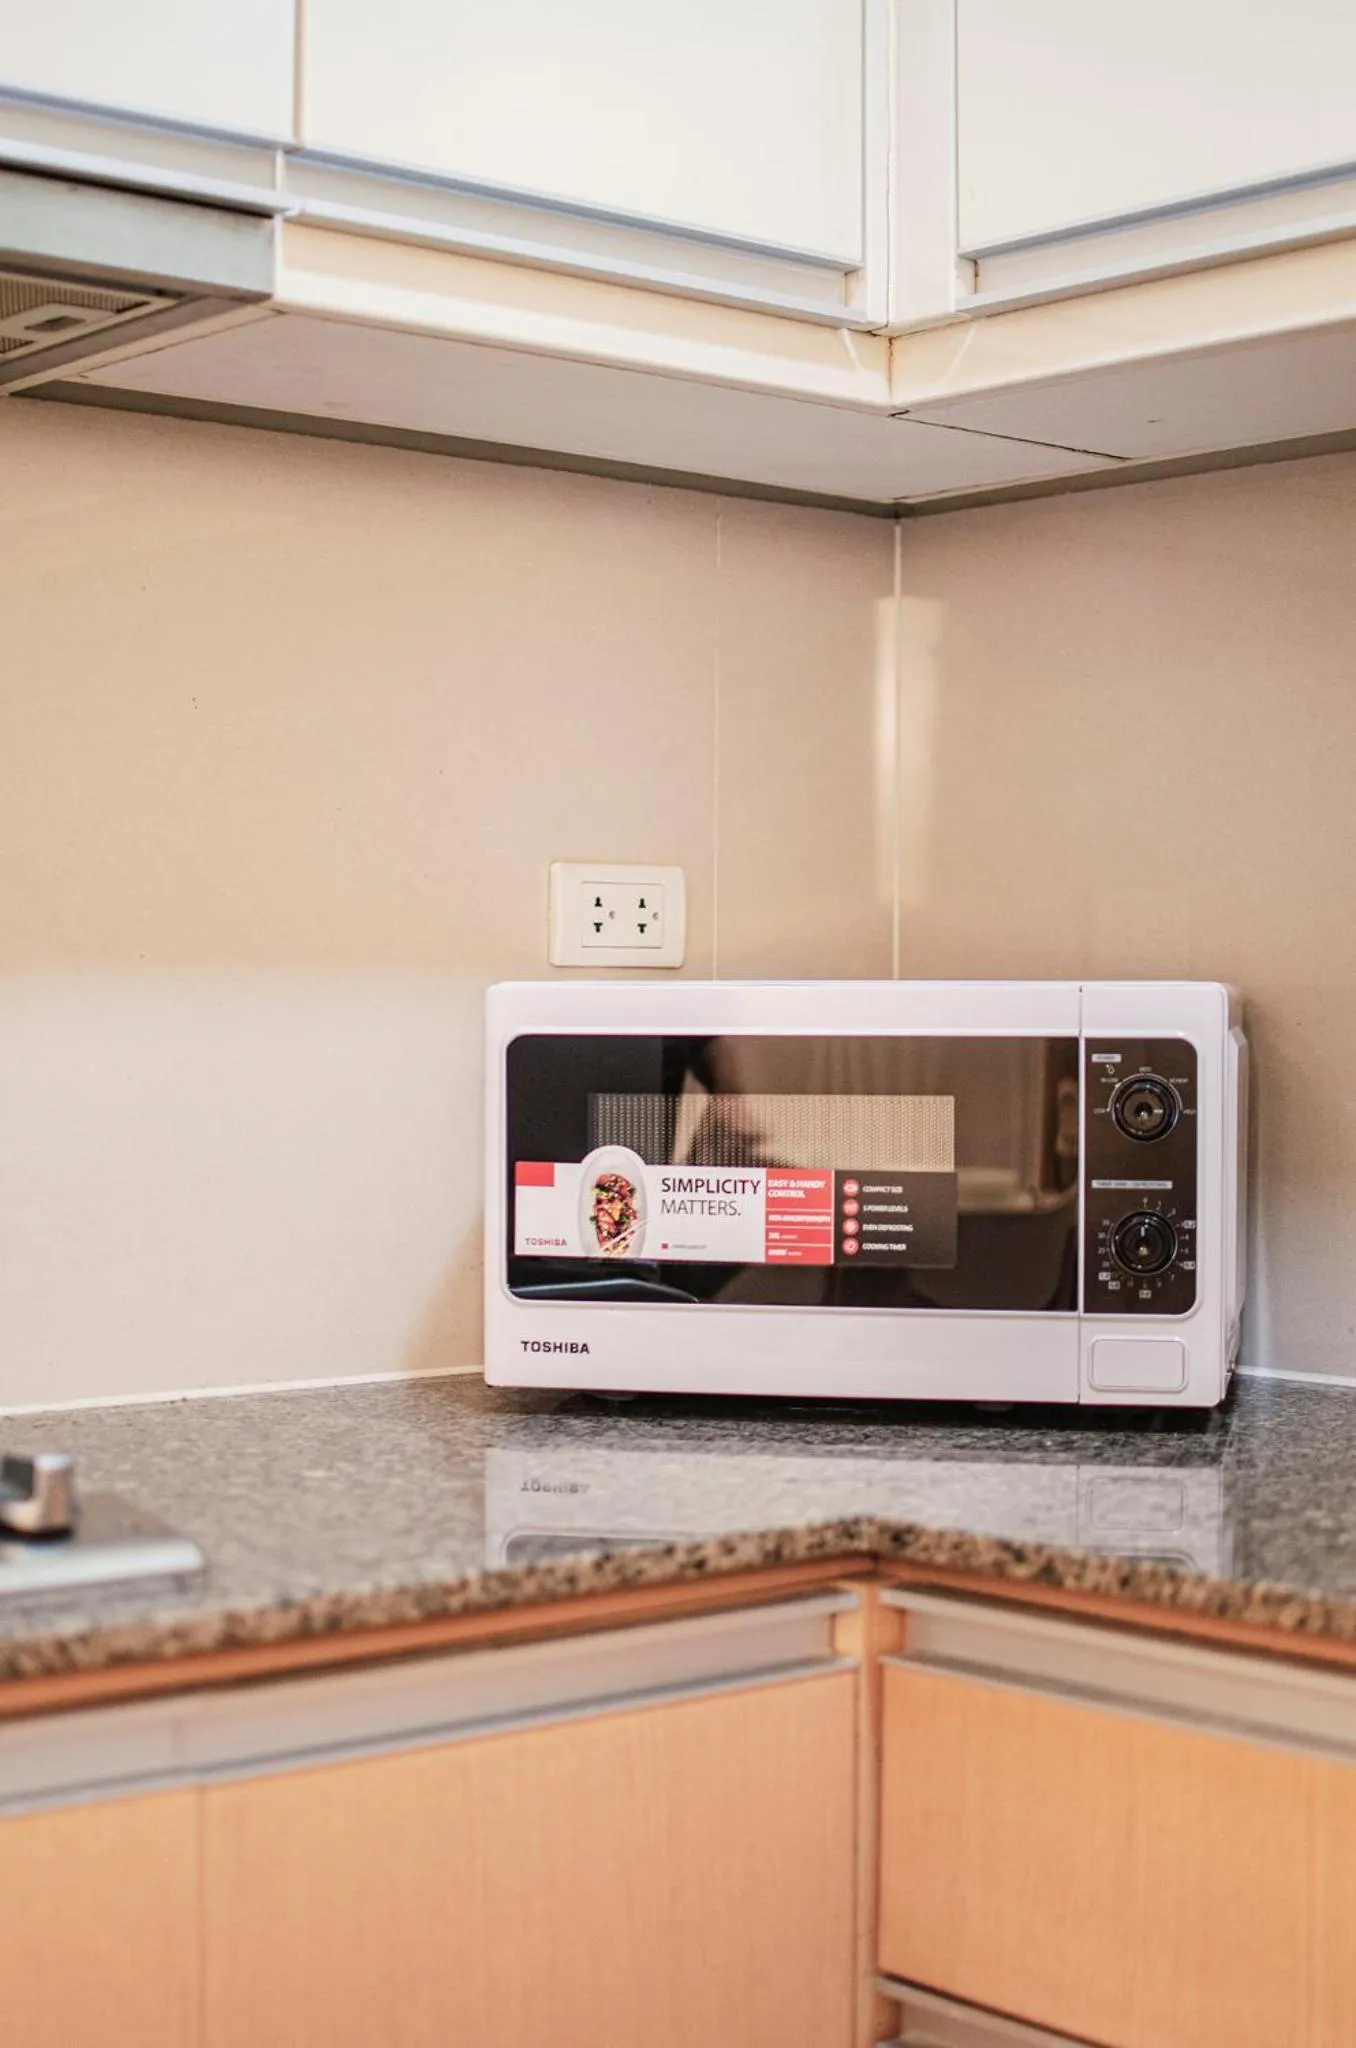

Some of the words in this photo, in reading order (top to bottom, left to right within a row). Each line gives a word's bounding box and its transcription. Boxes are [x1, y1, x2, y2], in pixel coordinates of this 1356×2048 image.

[661, 1177, 762, 1195] SIMPLICITY
[767, 1179, 789, 1188] EASY
[797, 1180, 826, 1190] HANDY
[767, 1189, 806, 1199] CONTROL
[661, 1199, 742, 1216] MATTERS.
[525, 1237, 568, 1246] TOSHIBA
[520, 1340, 590, 1354] TOSHIBA
